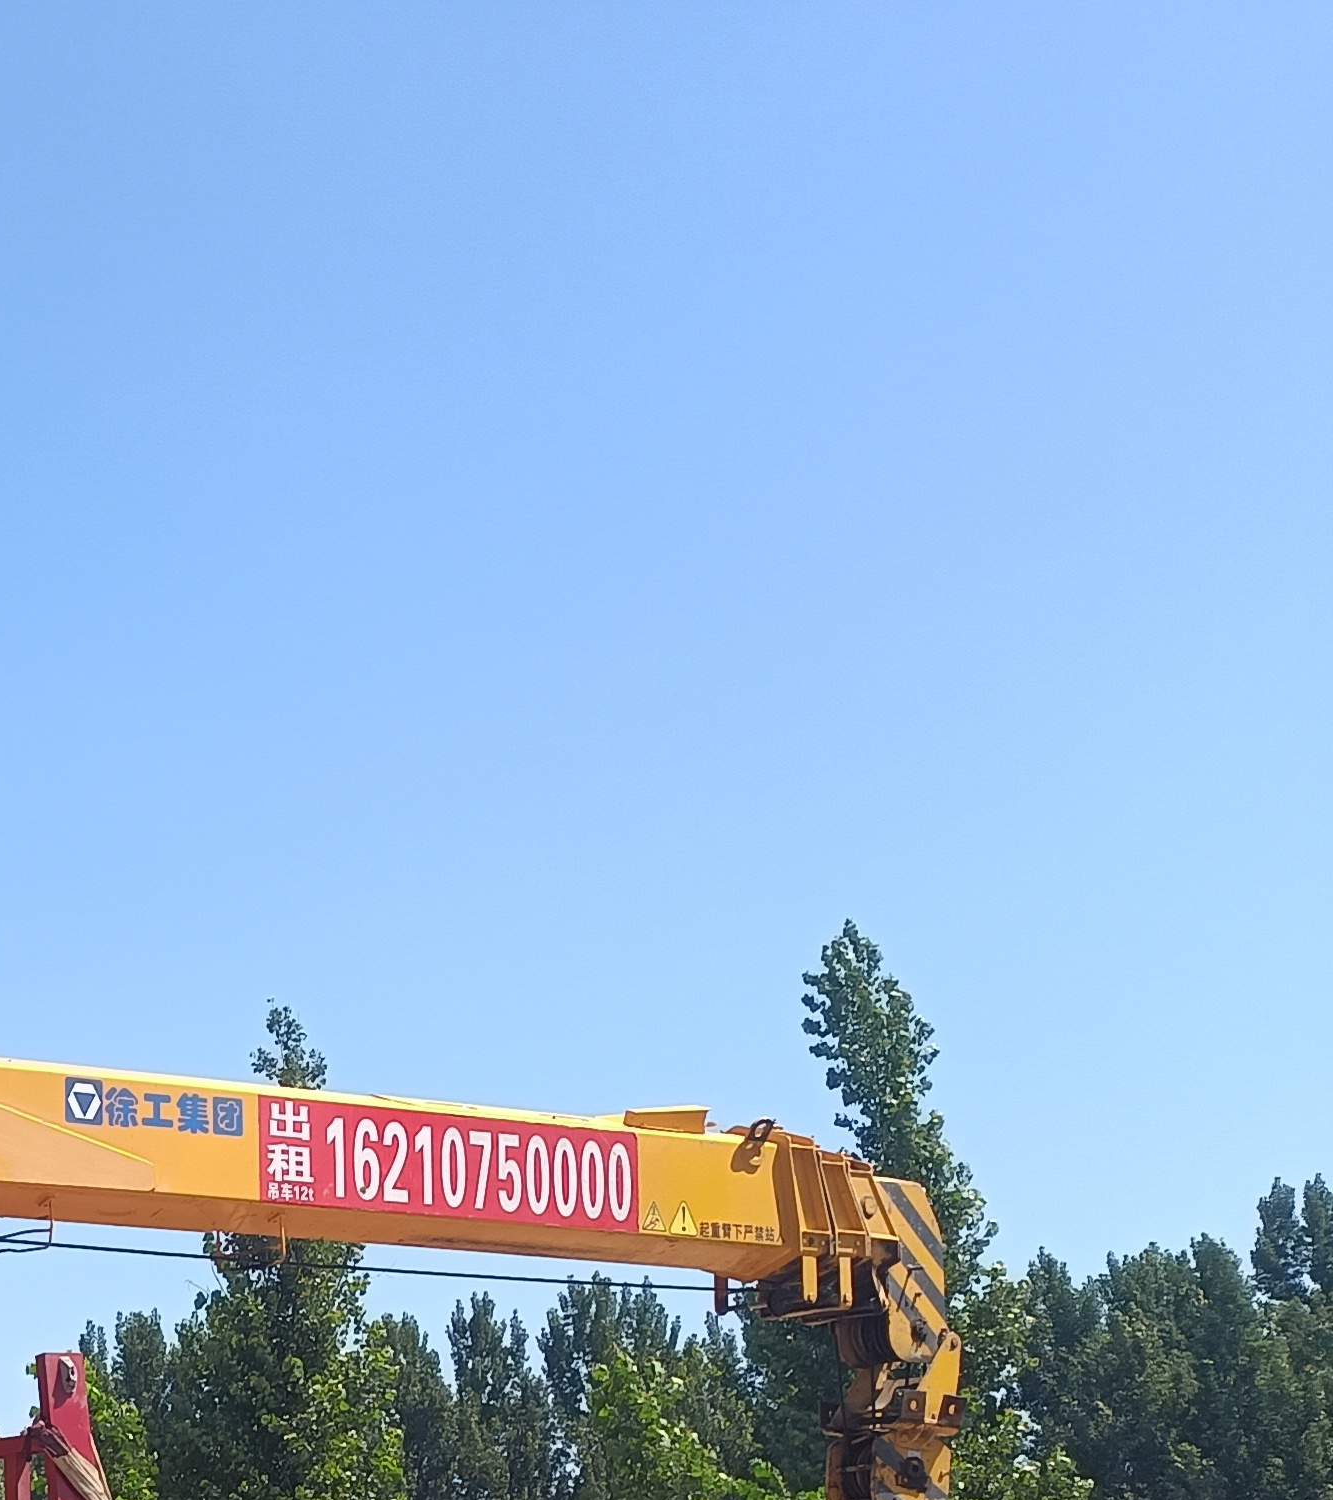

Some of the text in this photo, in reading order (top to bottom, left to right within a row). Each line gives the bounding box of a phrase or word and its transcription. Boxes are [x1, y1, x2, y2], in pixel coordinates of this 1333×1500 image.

[105, 1089, 244, 1137] 徐工集团
[267, 1101, 314, 1183] 出租
[326, 1116, 632, 1222] 16210750000
